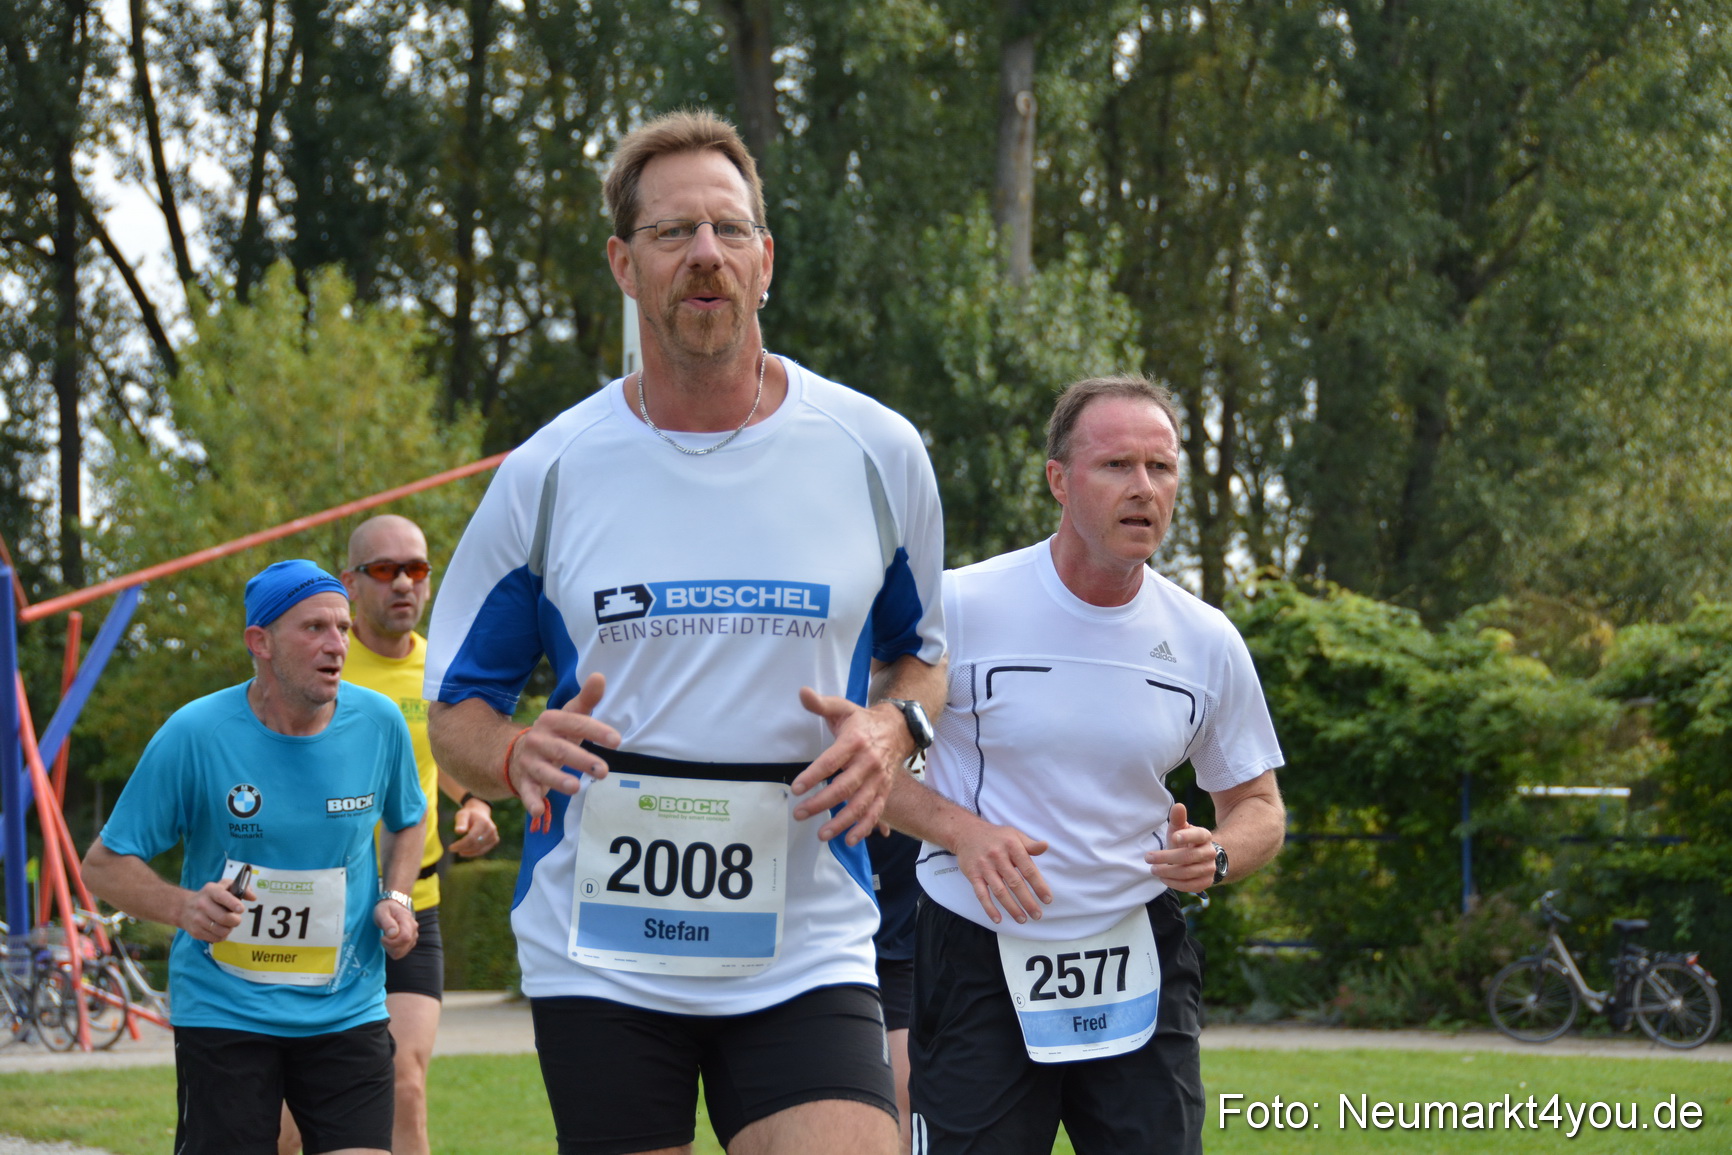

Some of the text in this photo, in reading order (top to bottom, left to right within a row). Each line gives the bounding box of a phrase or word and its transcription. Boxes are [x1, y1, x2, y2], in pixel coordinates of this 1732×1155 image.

[665, 585, 821, 611] BÜSCHEL
[598, 616, 827, 644] FEINSCHNEIDTEAM
[1149, 651, 1177, 663] adidas
[326, 793, 375, 813] BOCK
[659, 796, 730, 815] BOCK
[229, 823, 263, 832] PARTL
[606, 835, 754, 900] 2008
[269, 880, 314, 892] BOCK
[248, 903, 310, 940] 131
[643, 917, 710, 942] Stefan
[251, 950, 298, 964] Werner
[1025, 945, 1131, 1002] 2577
[1073, 1012, 1108, 1033] Fred
